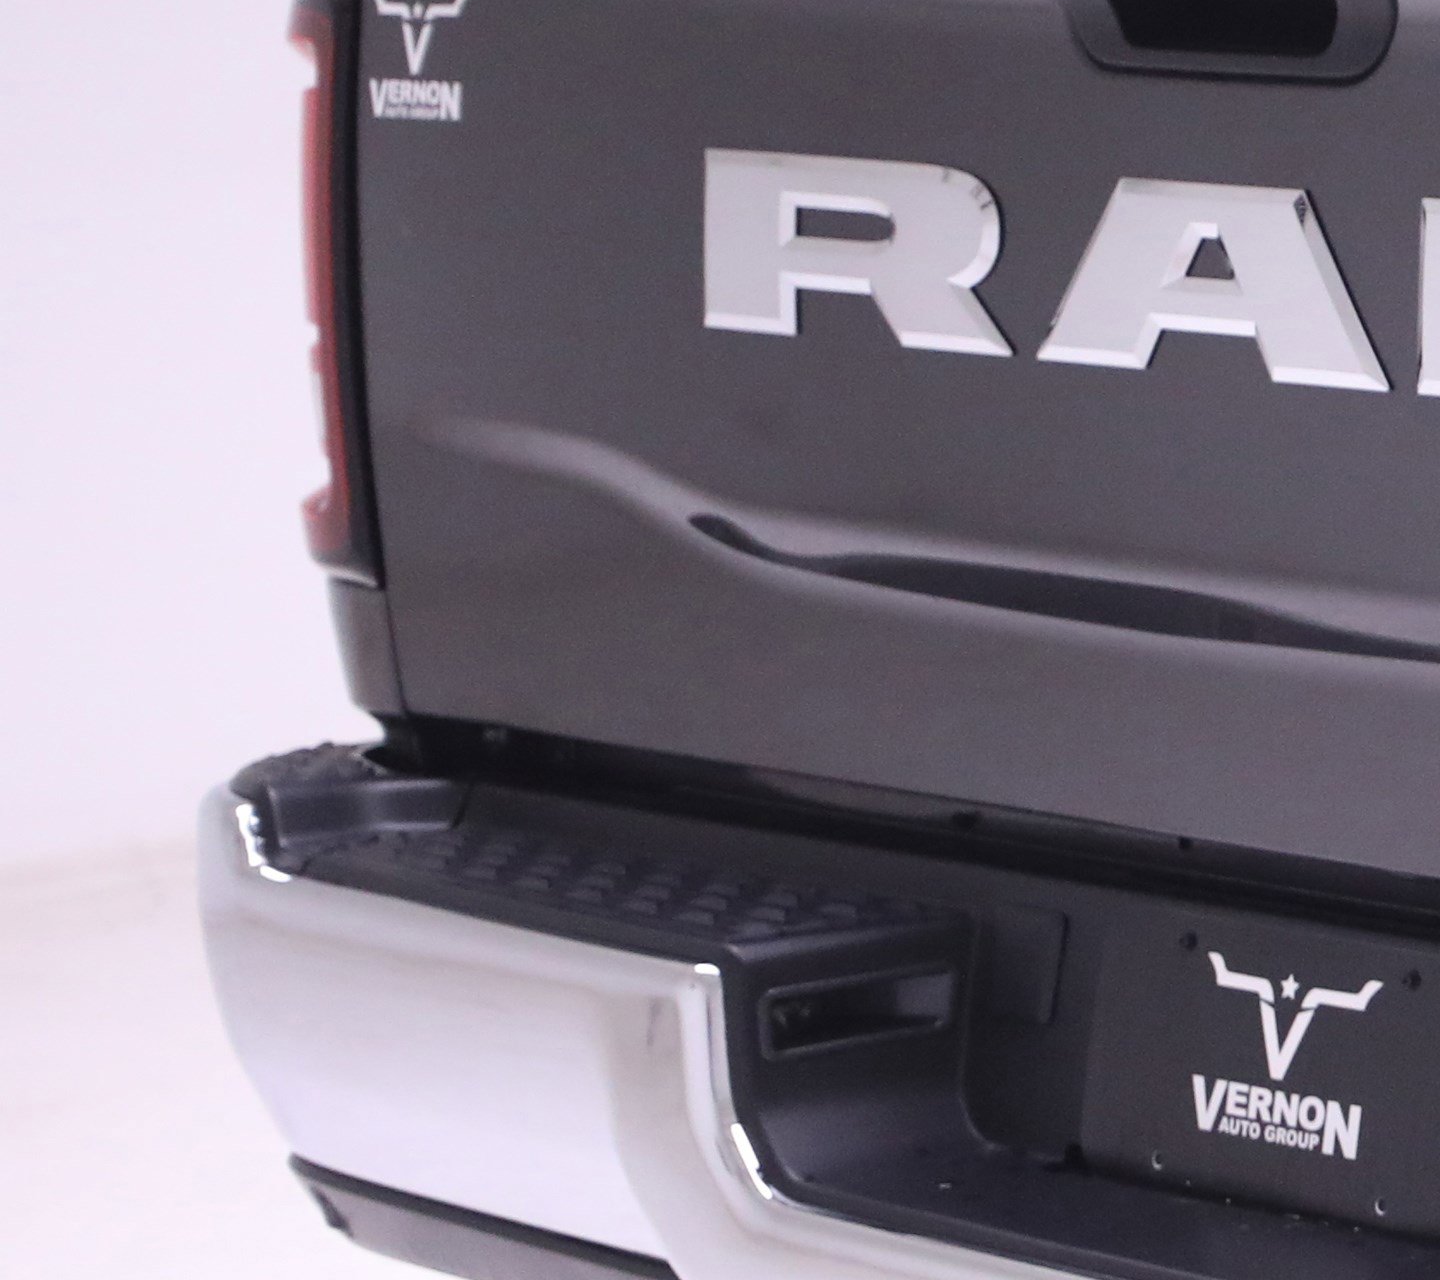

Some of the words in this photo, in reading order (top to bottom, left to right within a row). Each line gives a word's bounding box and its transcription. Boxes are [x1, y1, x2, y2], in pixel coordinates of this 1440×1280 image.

[369, 78, 462, 121] VERNON
[1192, 1074, 1362, 1160] VERNON
[1218, 1116, 1261, 1140] AUTO
[1263, 1126, 1321, 1151] GROUP
